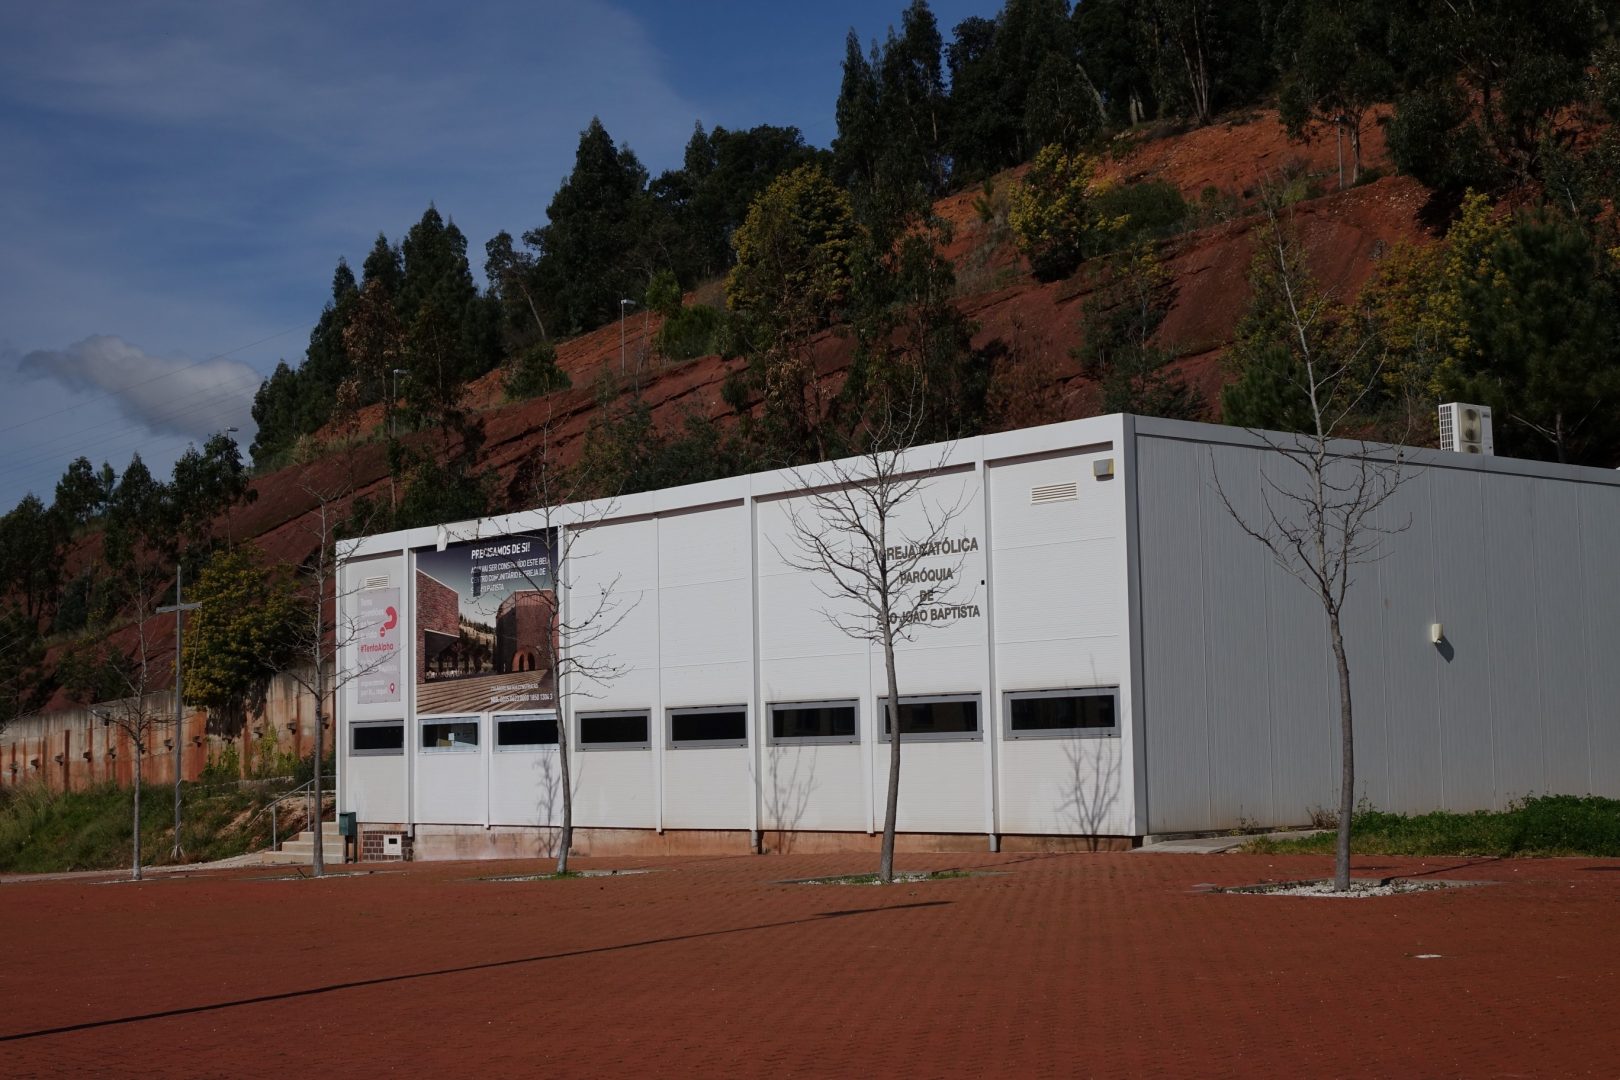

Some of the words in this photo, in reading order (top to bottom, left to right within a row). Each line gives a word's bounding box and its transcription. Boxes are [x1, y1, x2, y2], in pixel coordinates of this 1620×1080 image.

[471, 545, 510, 560] PRECISAMOS
[511, 543, 520, 554] DE
[920, 537, 979, 557] CATÓLICA
[489, 563, 498, 571] SER
[526, 559, 539, 567] ESTE
[900, 567, 953, 584] PARÓQUIA
[920, 590, 934, 602] DE
[930, 605, 980, 621] BAPTISTA
